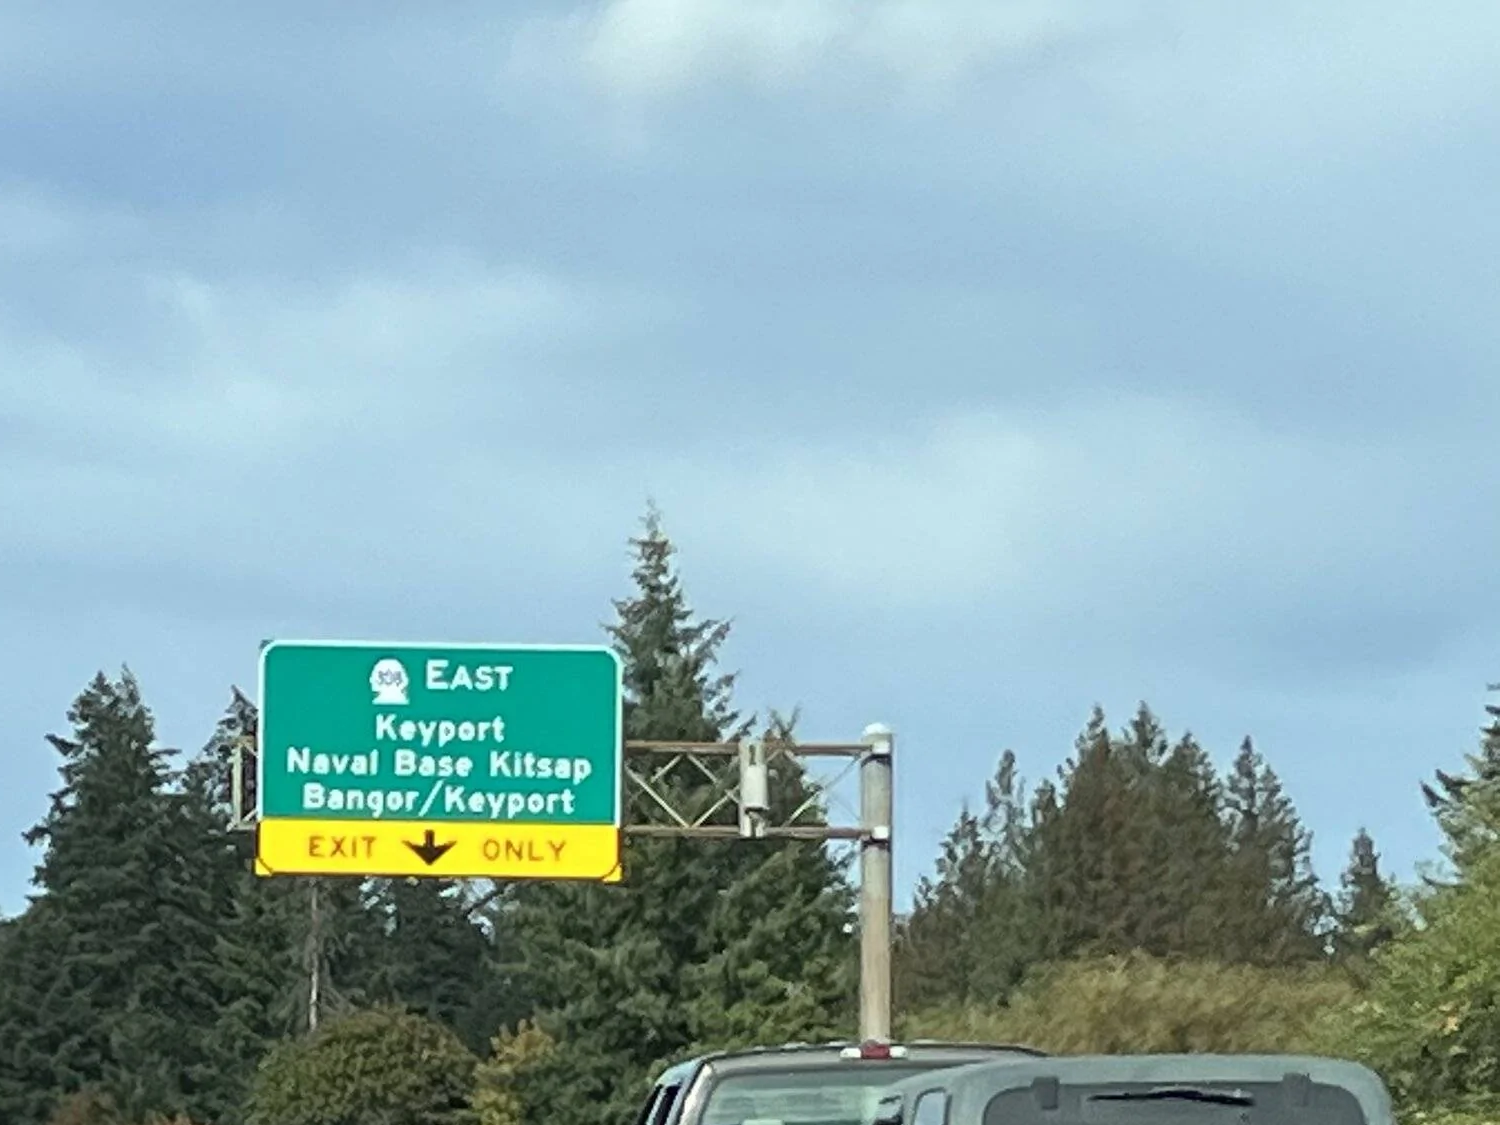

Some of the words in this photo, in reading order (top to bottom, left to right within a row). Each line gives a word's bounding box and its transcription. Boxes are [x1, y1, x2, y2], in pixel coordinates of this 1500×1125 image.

[426, 659, 513, 691] EAST
[376, 714, 505, 747] Keyport
[287, 747, 379, 775] Naval
[394, 749, 473, 777] Base
[490, 751, 592, 784] Kitsap
[303, 781, 575, 818] Bangor/Keyport
[308, 835, 377, 858] EXIT
[483, 838, 567, 863] ONLY
